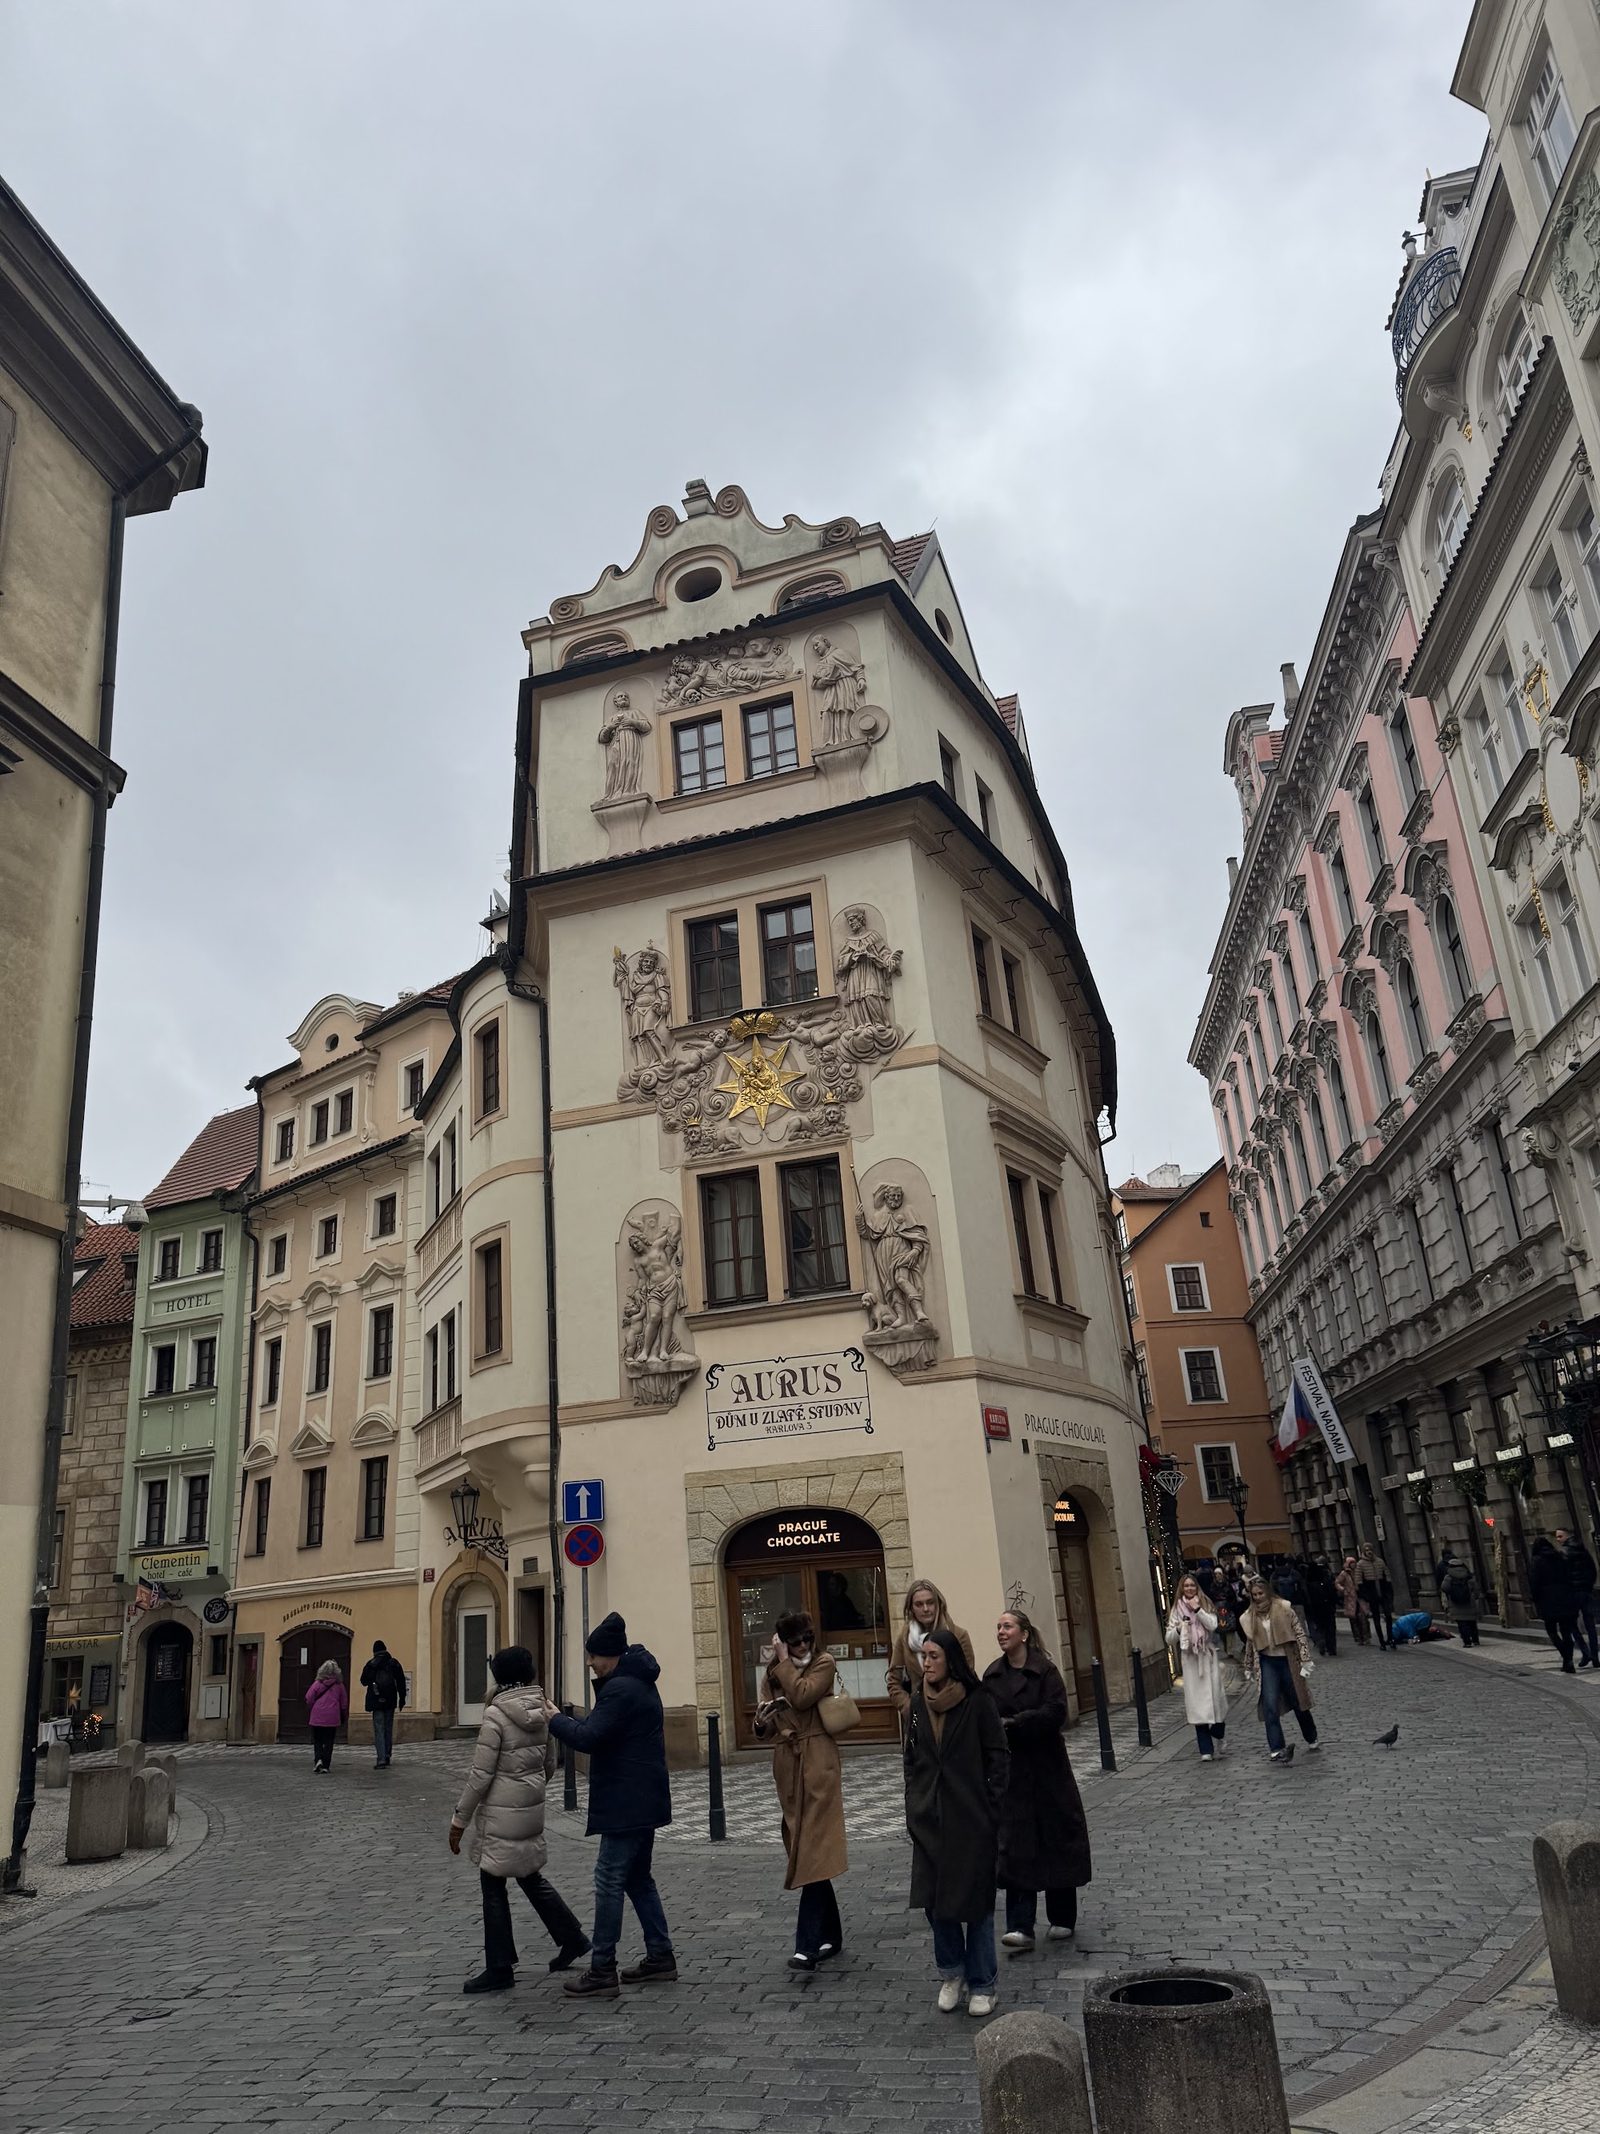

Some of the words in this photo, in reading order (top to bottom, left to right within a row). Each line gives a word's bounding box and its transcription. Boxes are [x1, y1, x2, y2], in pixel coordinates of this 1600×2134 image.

[166, 1293, 211, 1312] HOTEL
[730, 1363, 842, 1404] AURUS
[715, 1411, 747, 1429] DŮM
[750, 1412, 759, 1426] U
[762, 1404, 806, 1425] ZLATÉ
[808, 1401, 863, 1419] STUDNY
[1300, 1365, 1326, 1408] FESTIVAL
[1320, 1410, 1347, 1454] NADAMU
[764, 1424, 805, 1434] KARLOVA
[806, 1422, 813, 1430] 3
[1024, 1413, 1061, 1436] PRAGUE
[1062, 1420, 1107, 1444] CHOCOLATE
[778, 1519, 828, 1533] PRAGUE
[767, 1532, 841, 1547] CHOCOLATE
[141, 1553, 201, 1570] Clementin
[147, 1570, 165, 1580] hotel
[177, 1567, 193, 1578] café
[46, 1641, 74, 1652] BLACK
[78, 1639, 99, 1649] STAR
